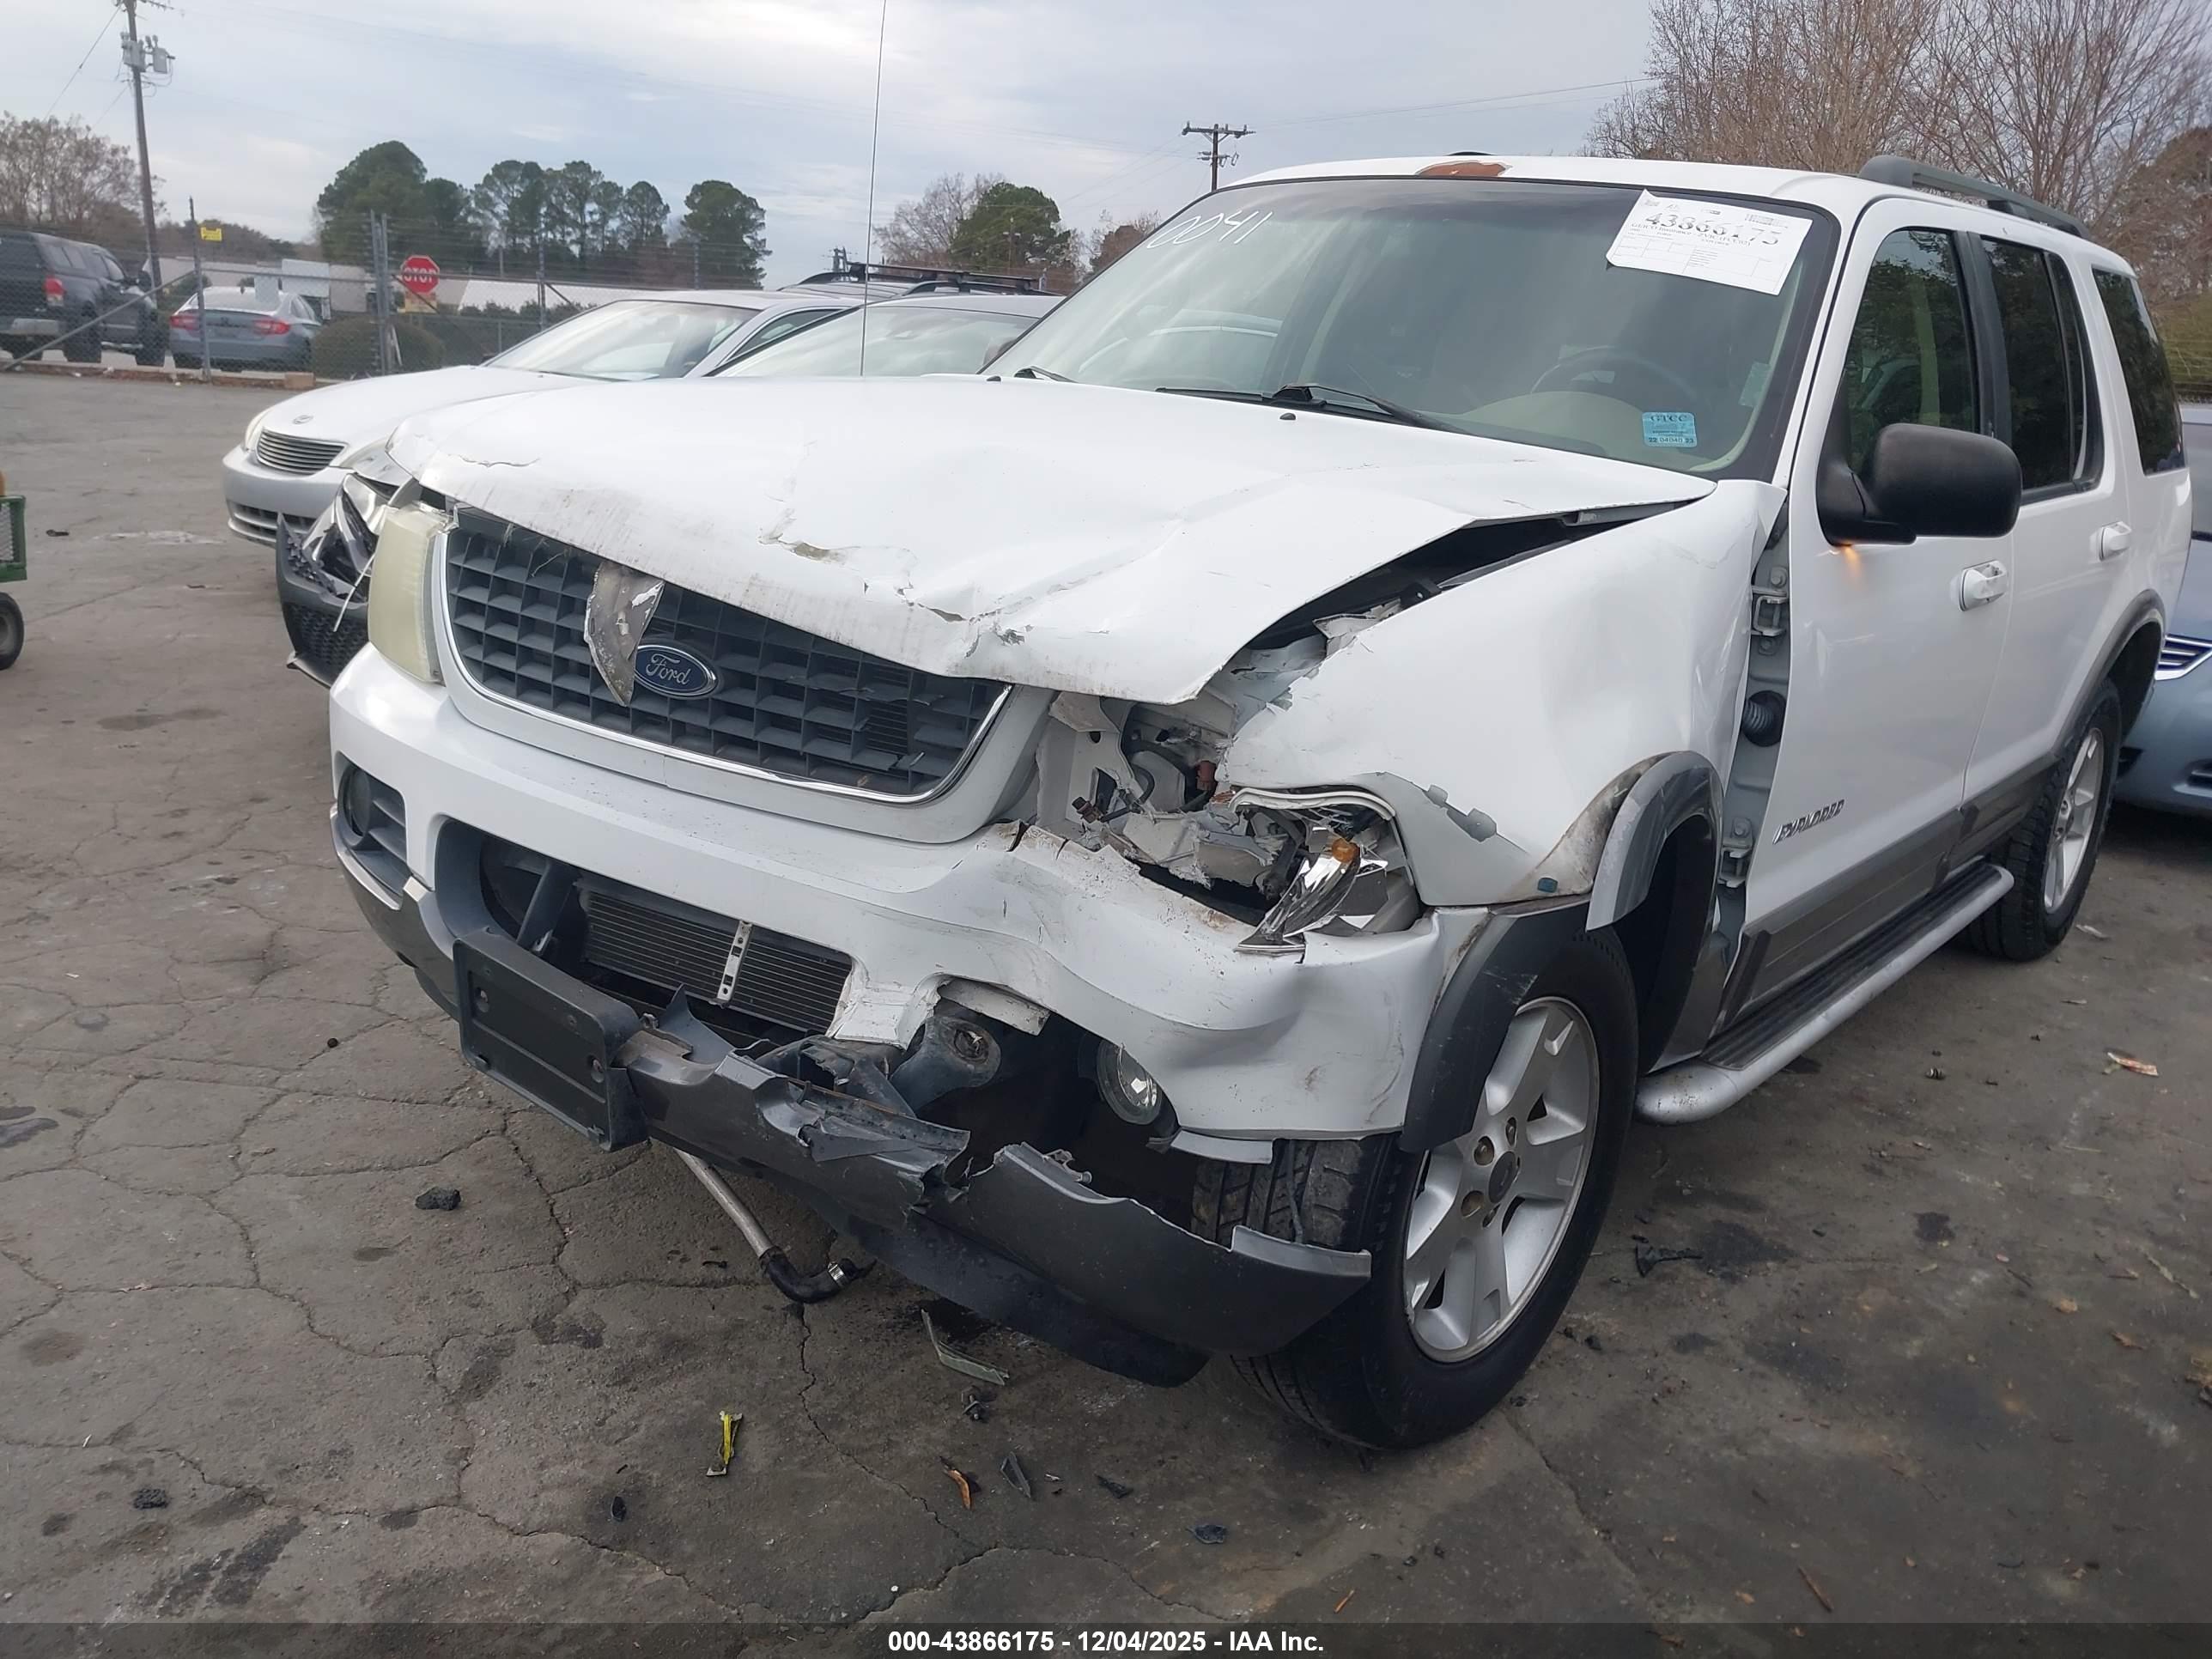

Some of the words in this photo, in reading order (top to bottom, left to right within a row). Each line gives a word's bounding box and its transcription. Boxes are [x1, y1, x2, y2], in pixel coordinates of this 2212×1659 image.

[1146, 210, 1273, 249] 0041
[1645, 212, 1783, 246] 43866175
[404, 267, 436, 283] STOP
[646, 653, 691, 685] Ford
[1772, 799, 1844, 845] EXPLORER
